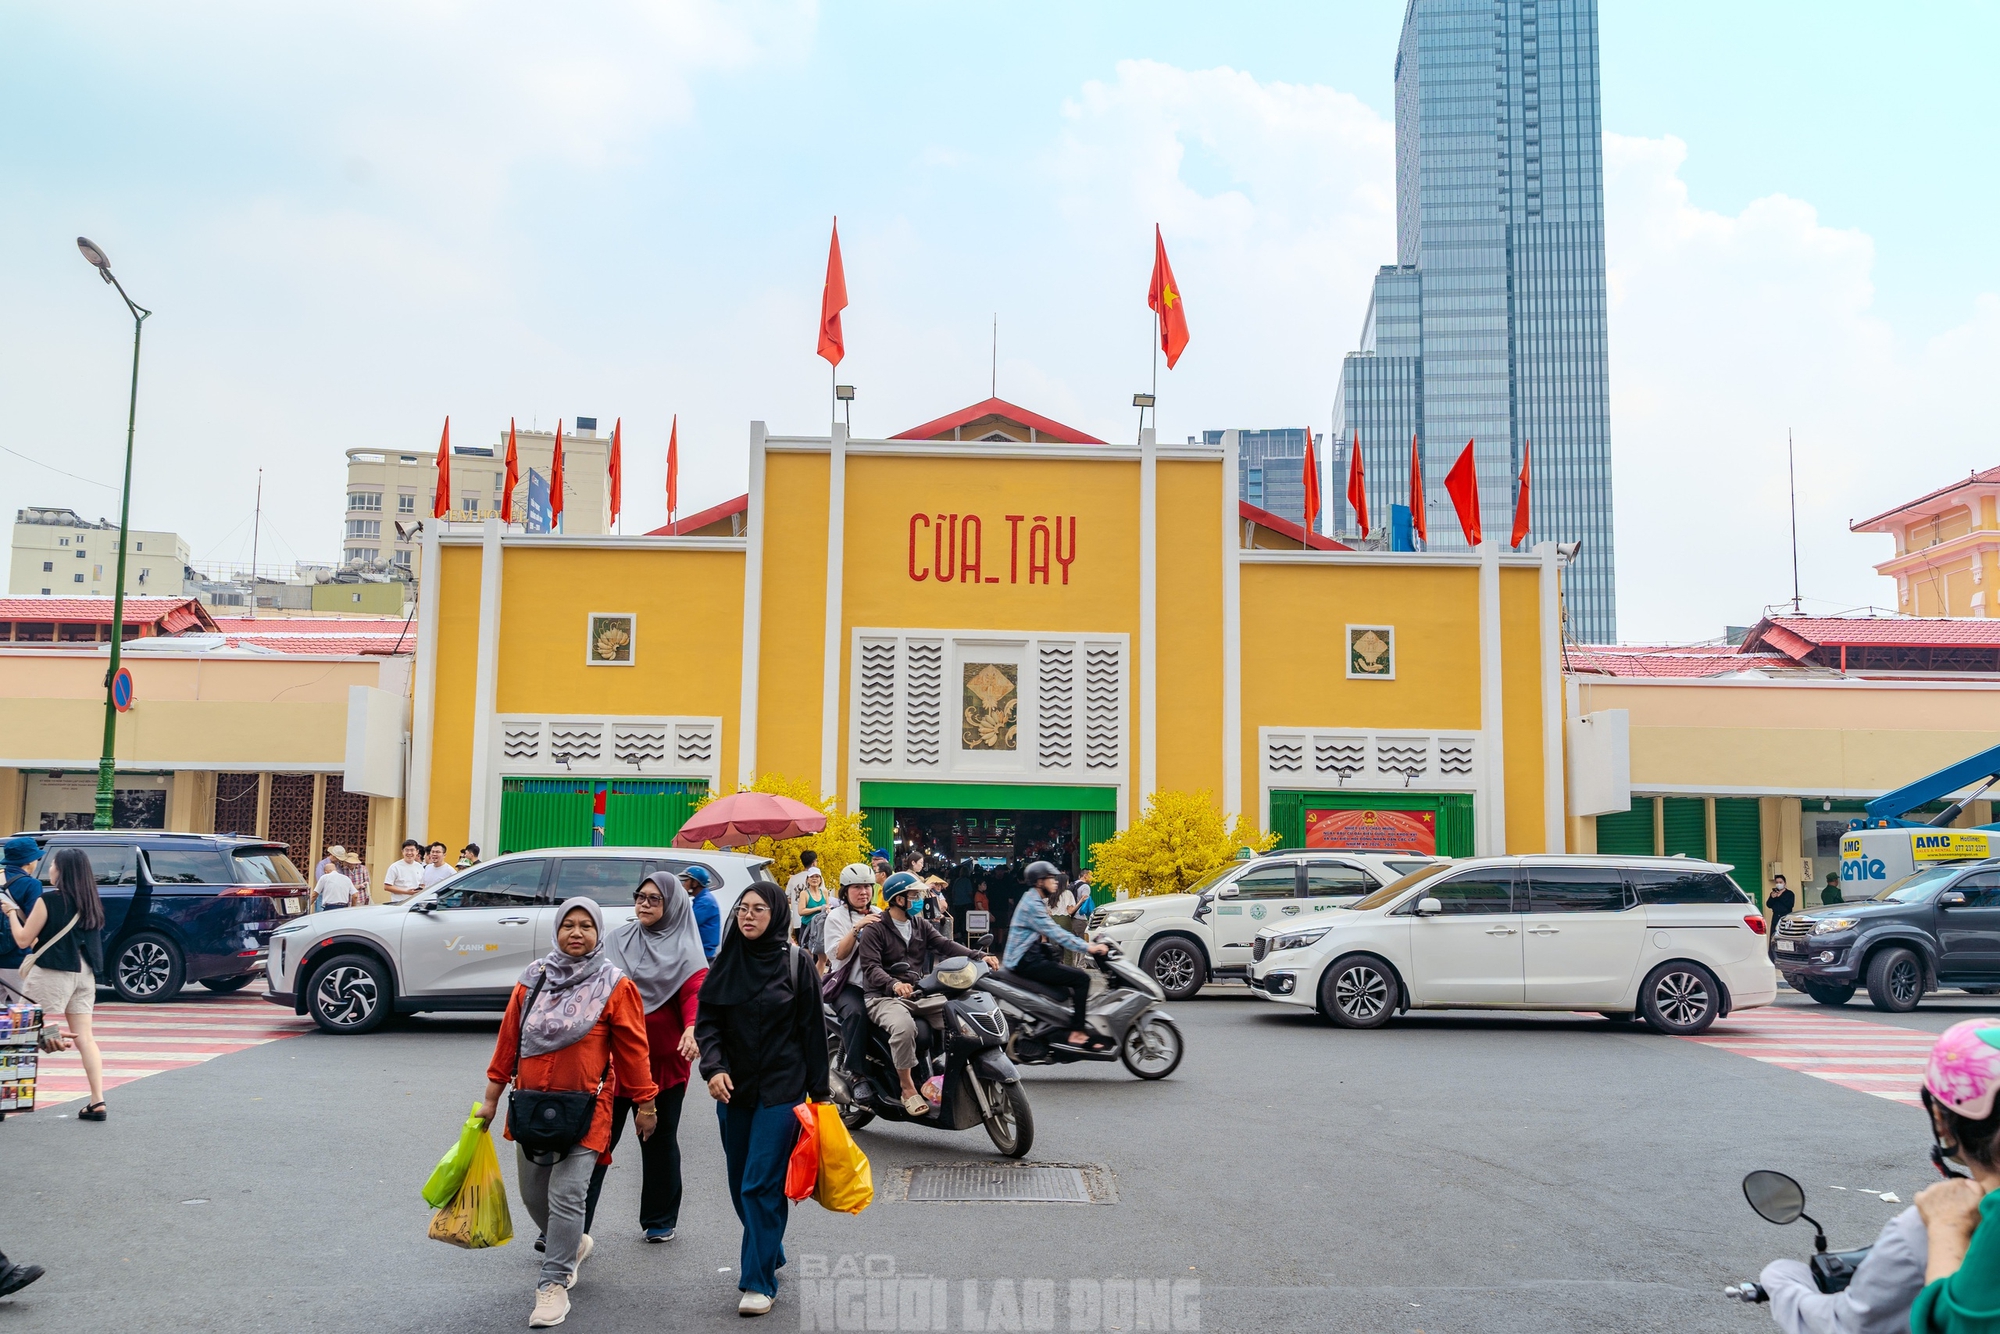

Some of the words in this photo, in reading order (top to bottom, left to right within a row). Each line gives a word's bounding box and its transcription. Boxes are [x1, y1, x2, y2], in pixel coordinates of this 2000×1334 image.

[477, 509, 529, 523] HOEL
[1844, 840, 1860, 853] AMC
[1916, 836, 1950, 848] AMC
[485, 943, 499, 951] SM
